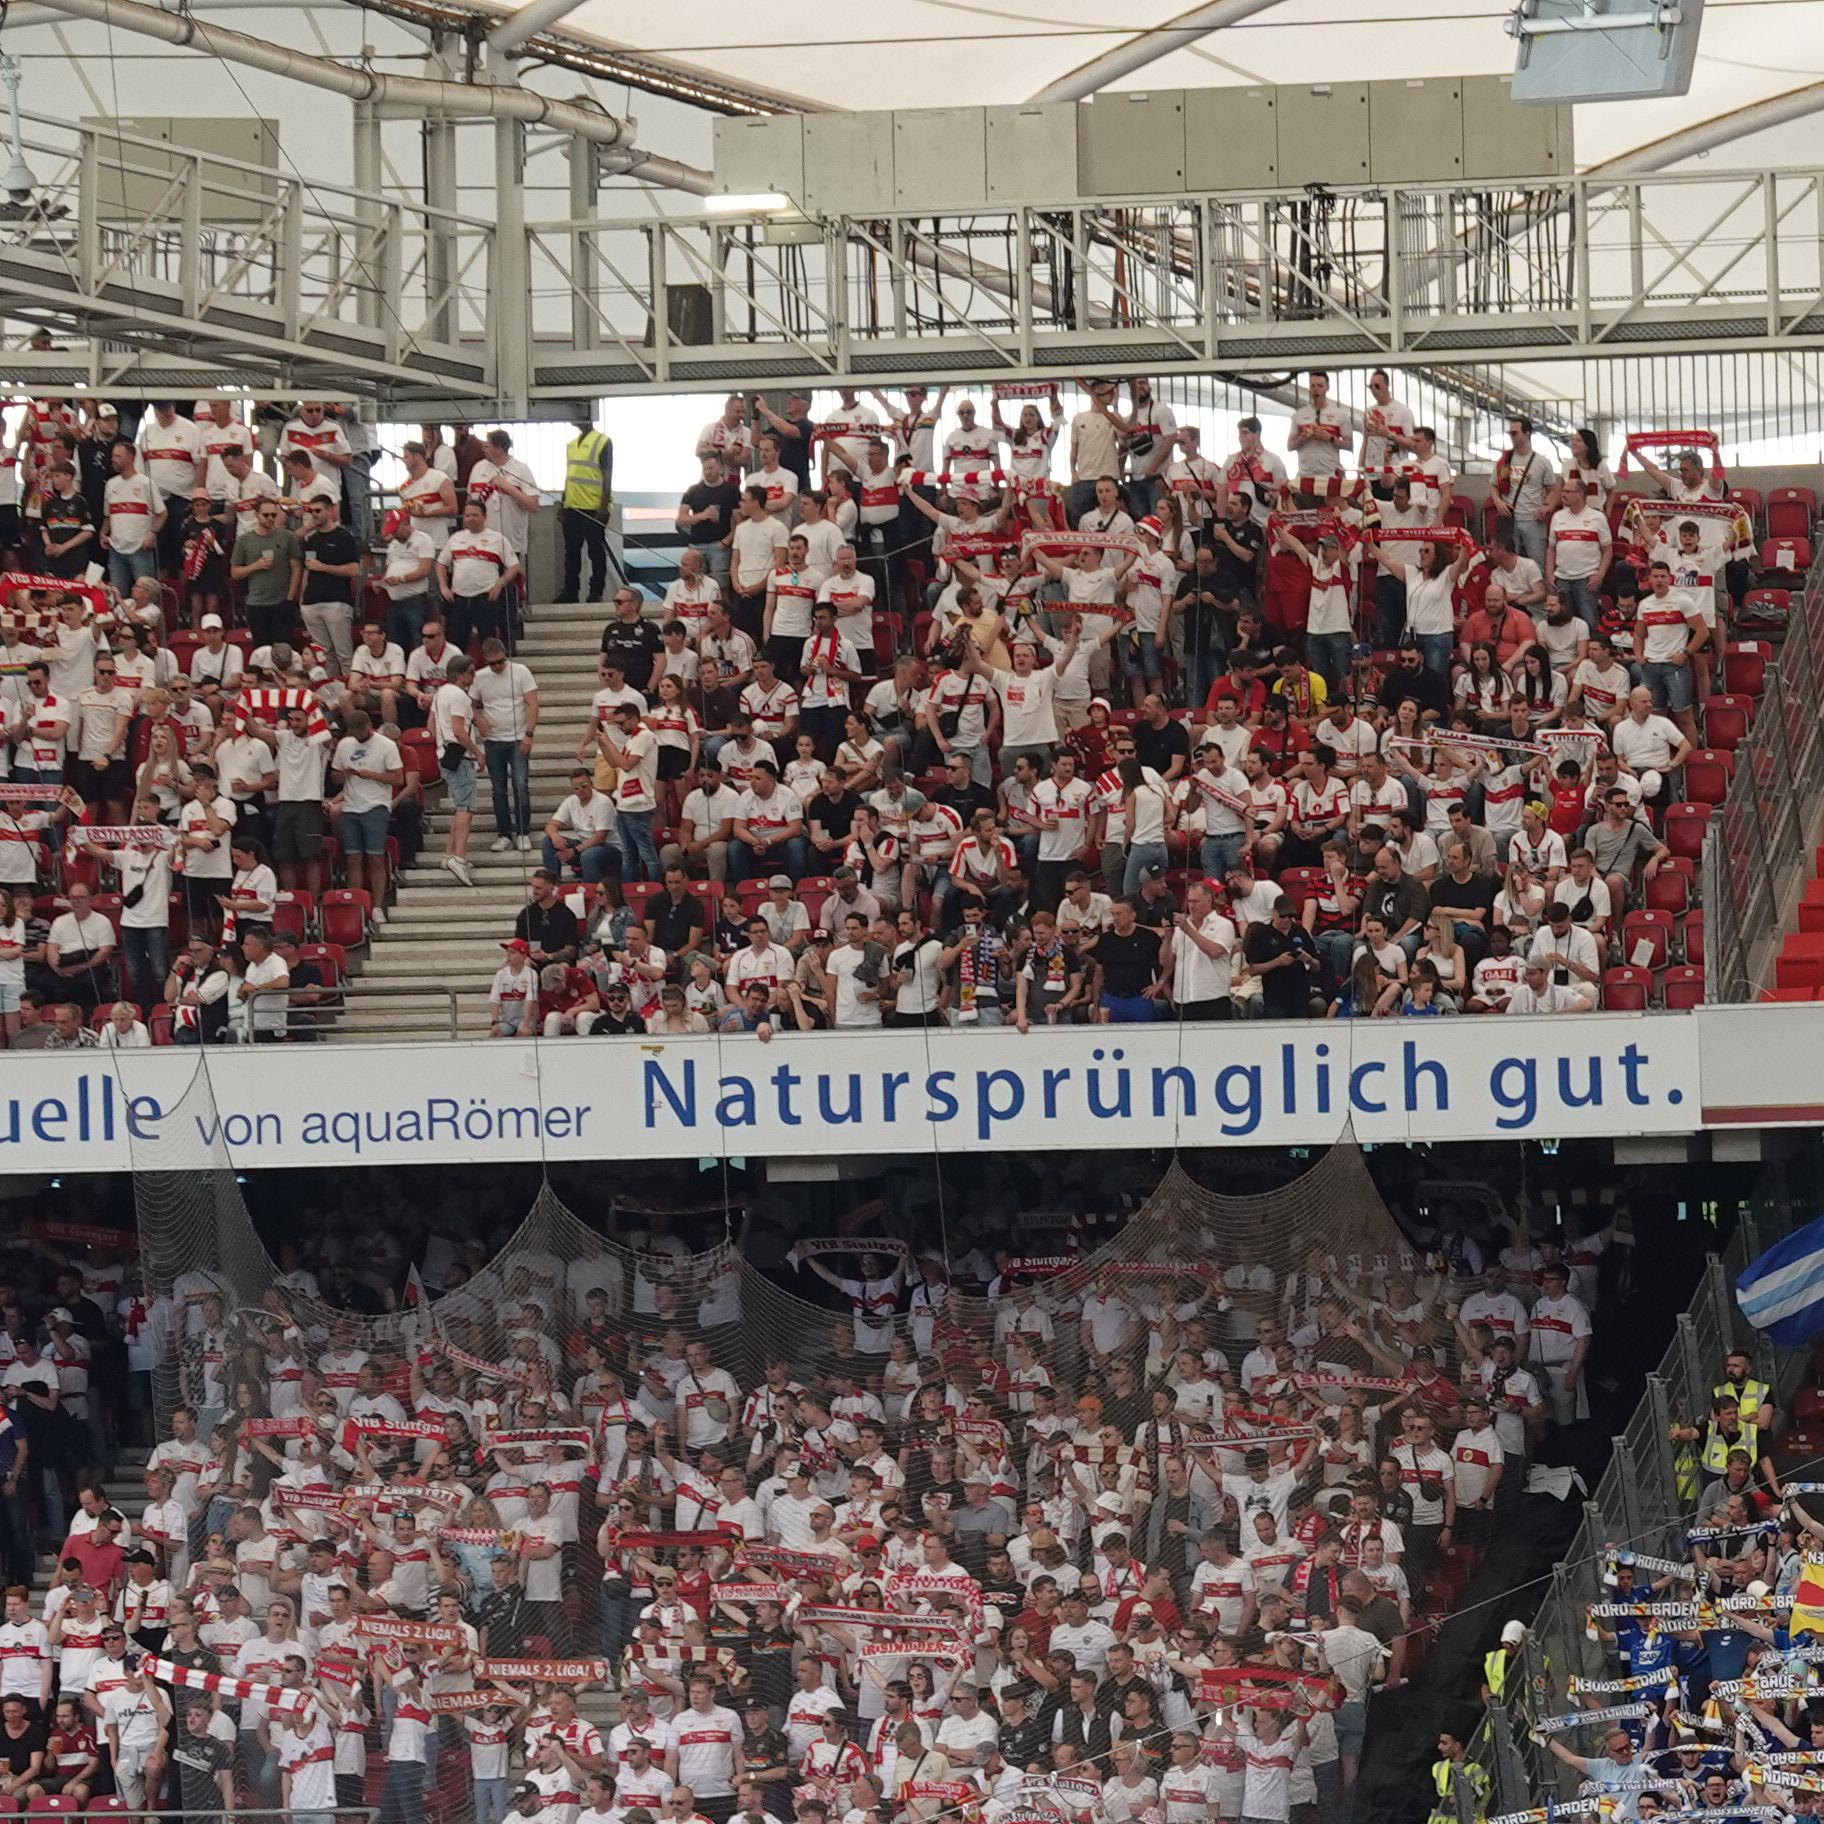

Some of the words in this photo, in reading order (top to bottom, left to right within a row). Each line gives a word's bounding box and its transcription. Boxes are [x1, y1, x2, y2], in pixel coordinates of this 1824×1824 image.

[644, 1041, 1449, 1139] Natursprünglich
[1489, 1043, 1684, 1130] gut.
[196, 1112, 282, 1147] von
[301, 1096, 593, 1156] aquaRömer
[384, 1419, 445, 1434] Stuttgar
[1591, 1602, 1630, 1618] NORD
[1651, 1601, 1699, 1617] BADEN
[361, 1619, 410, 1638] NIEMALS
[489, 1662, 540, 1677] NIEMALS
[544, 1662, 555, 1676] 2.
[558, 1661, 590, 1677] LIGA!
[1762, 1768, 1800, 1787] NORD
[1554, 1799, 1599, 1818] BADEN
